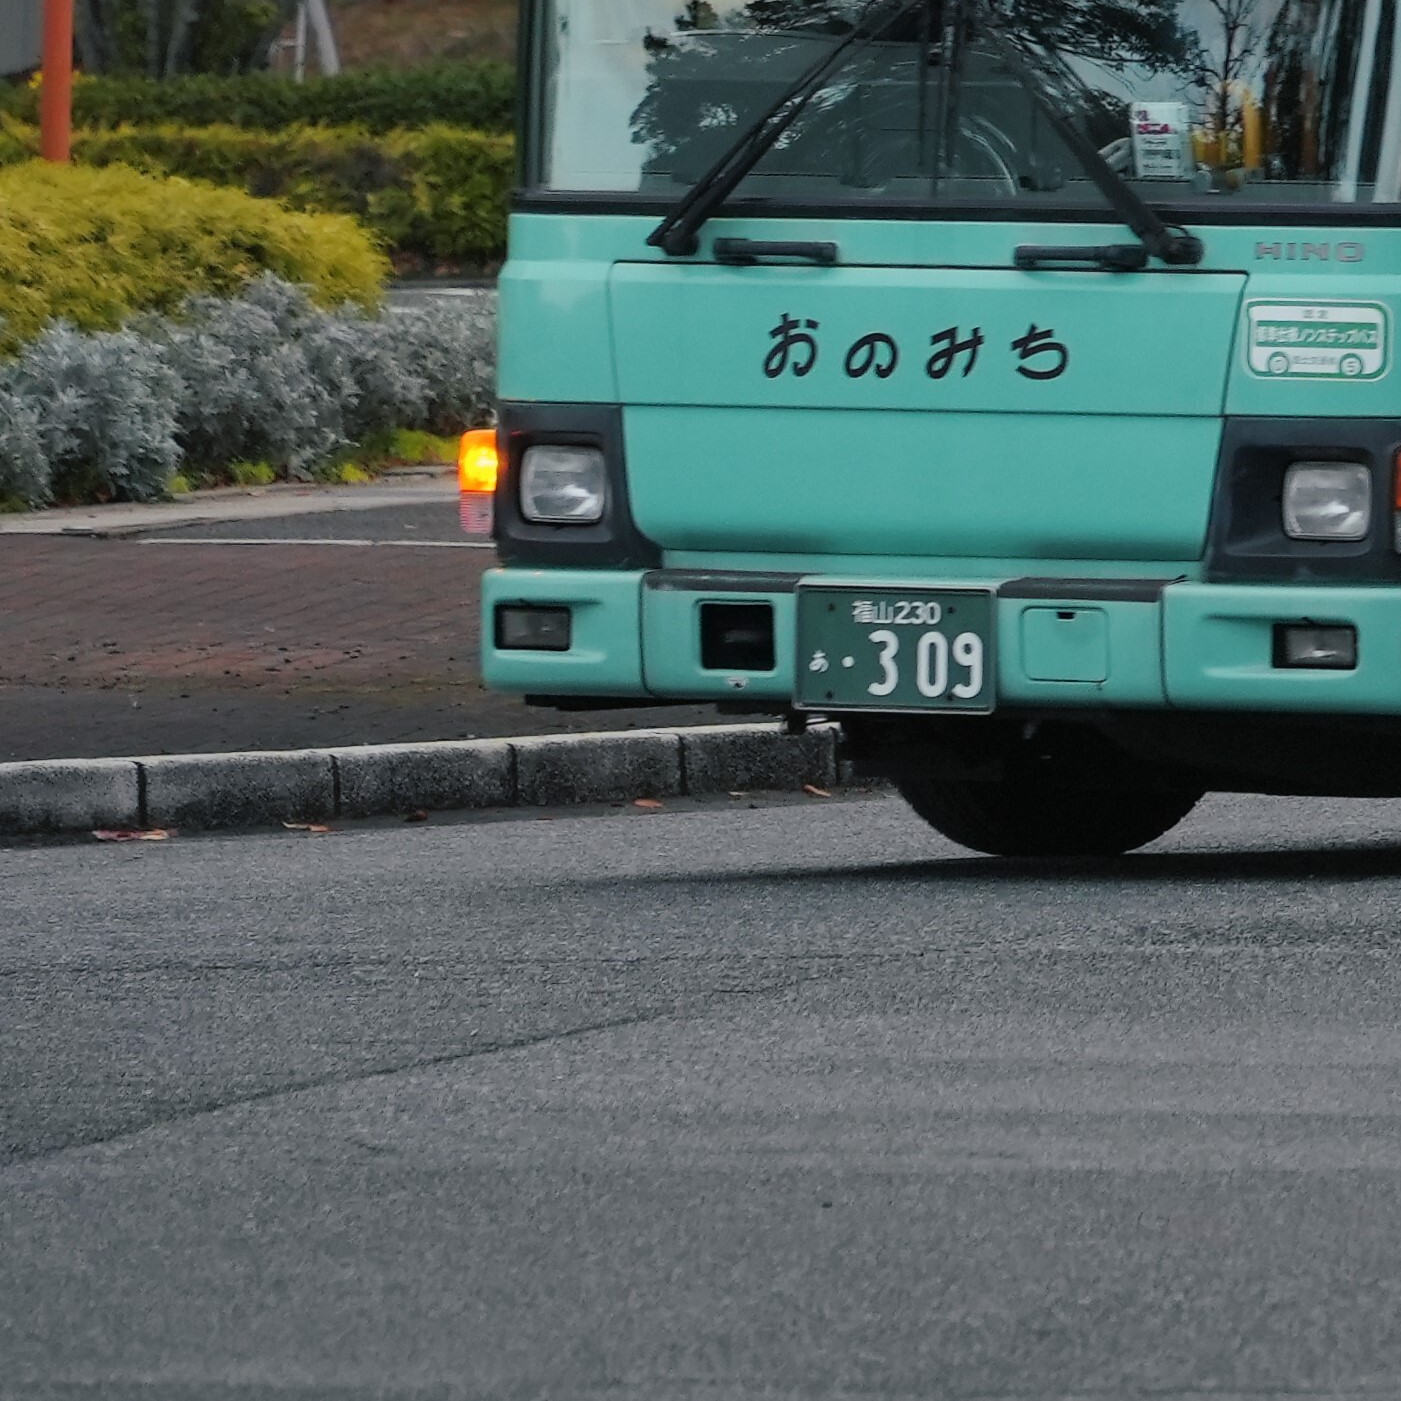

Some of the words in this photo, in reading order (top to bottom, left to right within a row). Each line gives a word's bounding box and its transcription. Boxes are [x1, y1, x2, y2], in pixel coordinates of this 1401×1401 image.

[1254, 241, 1367, 263] HINO
[763, 312, 1070, 380] おのみち
